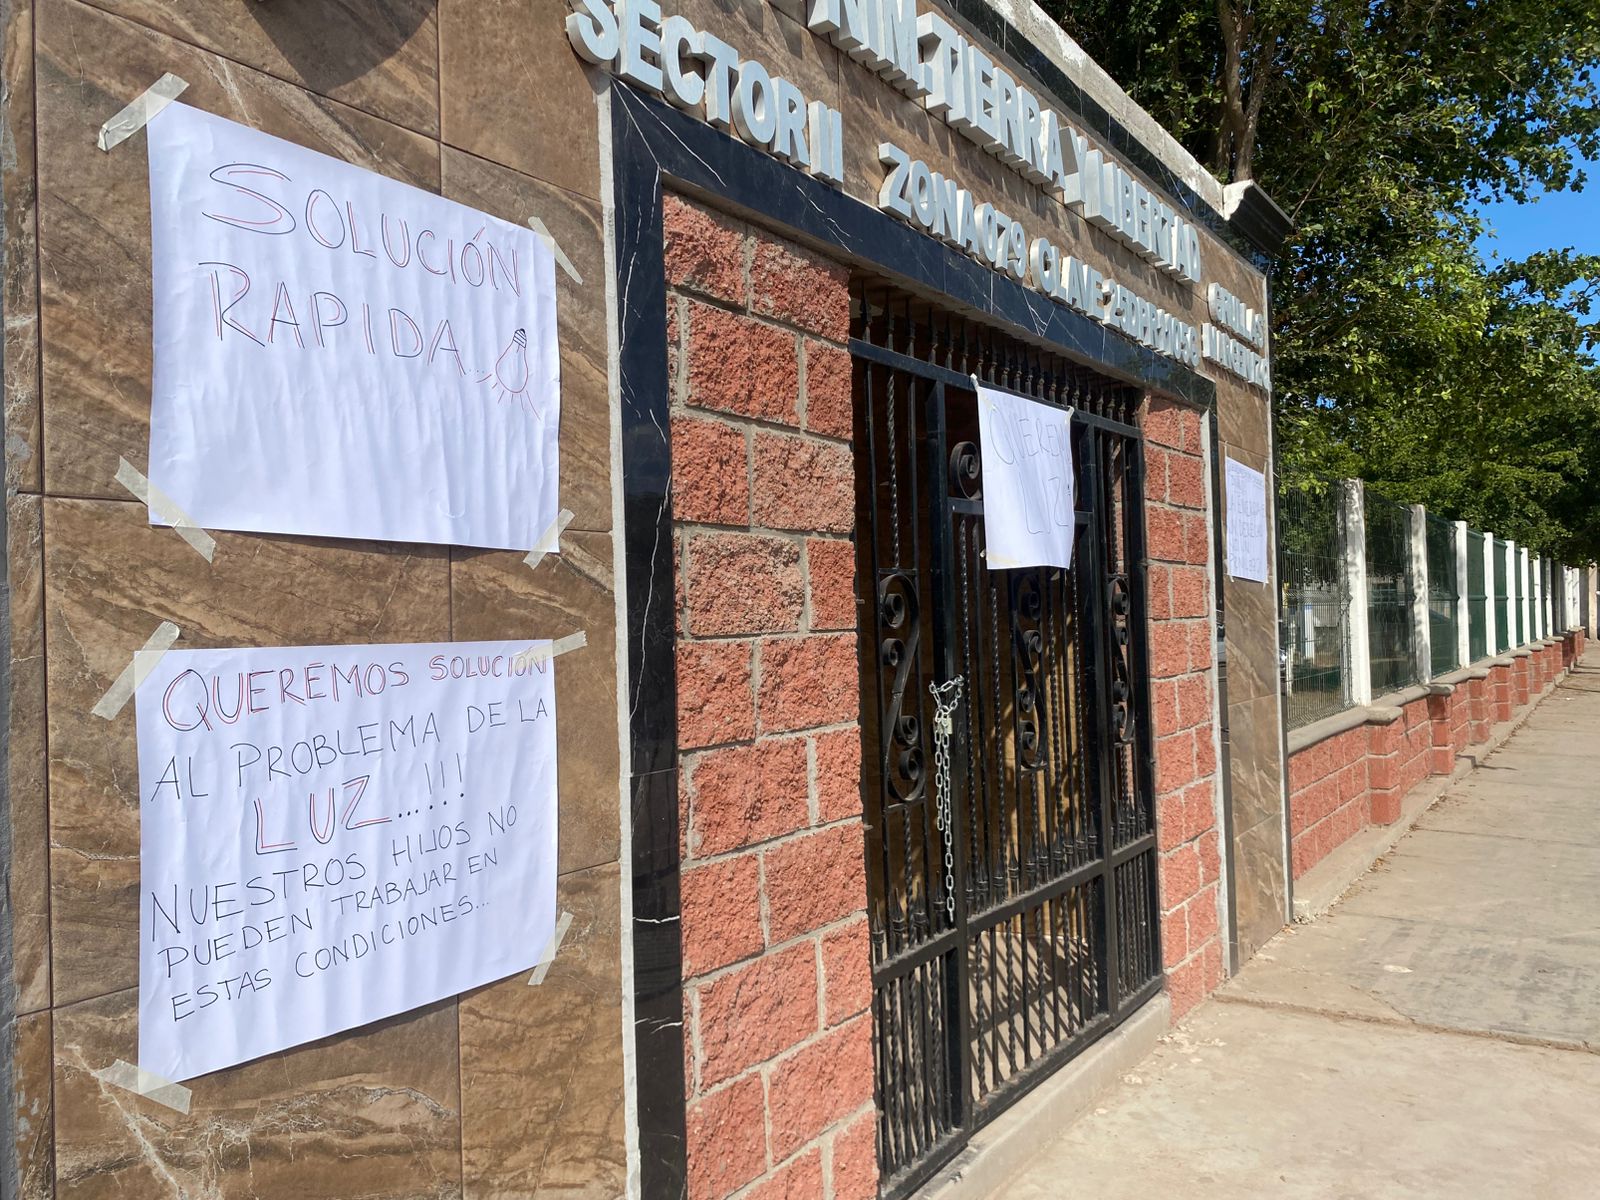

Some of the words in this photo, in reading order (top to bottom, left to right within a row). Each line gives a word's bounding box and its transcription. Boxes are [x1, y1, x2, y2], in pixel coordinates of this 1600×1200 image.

[567, 0, 810, 168] SECTOR
[878, 142, 981, 256] ZONA
[973, 202, 1027, 280] 079
[1030, 237, 1104, 322] CLAVE
[917, 12, 1066, 193] TIERRA
[1060, 126, 1089, 208] Y
[1084, 149, 1201, 285] LIBERTAD
[202, 163, 522, 298] SOLUCIÓN
[1207, 283, 1265, 349] GRULLAS
[151, 755, 209, 802] AL
[230, 712, 441, 788] PROBLEMA
[467, 701, 506, 734] DE
[518, 698, 549, 723] LA
[162, 662, 409, 732] QUEREMOS
[151, 853, 367, 942] NUESTROS
[392, 821, 471, 867] HIJOS
[487, 804, 518, 836] NO
[157, 908, 313, 978] PUEDEN
[331, 863, 457, 916] TRABAJAR
[467, 847, 499, 875] EN
[171, 968, 272, 1022] ESTAS
